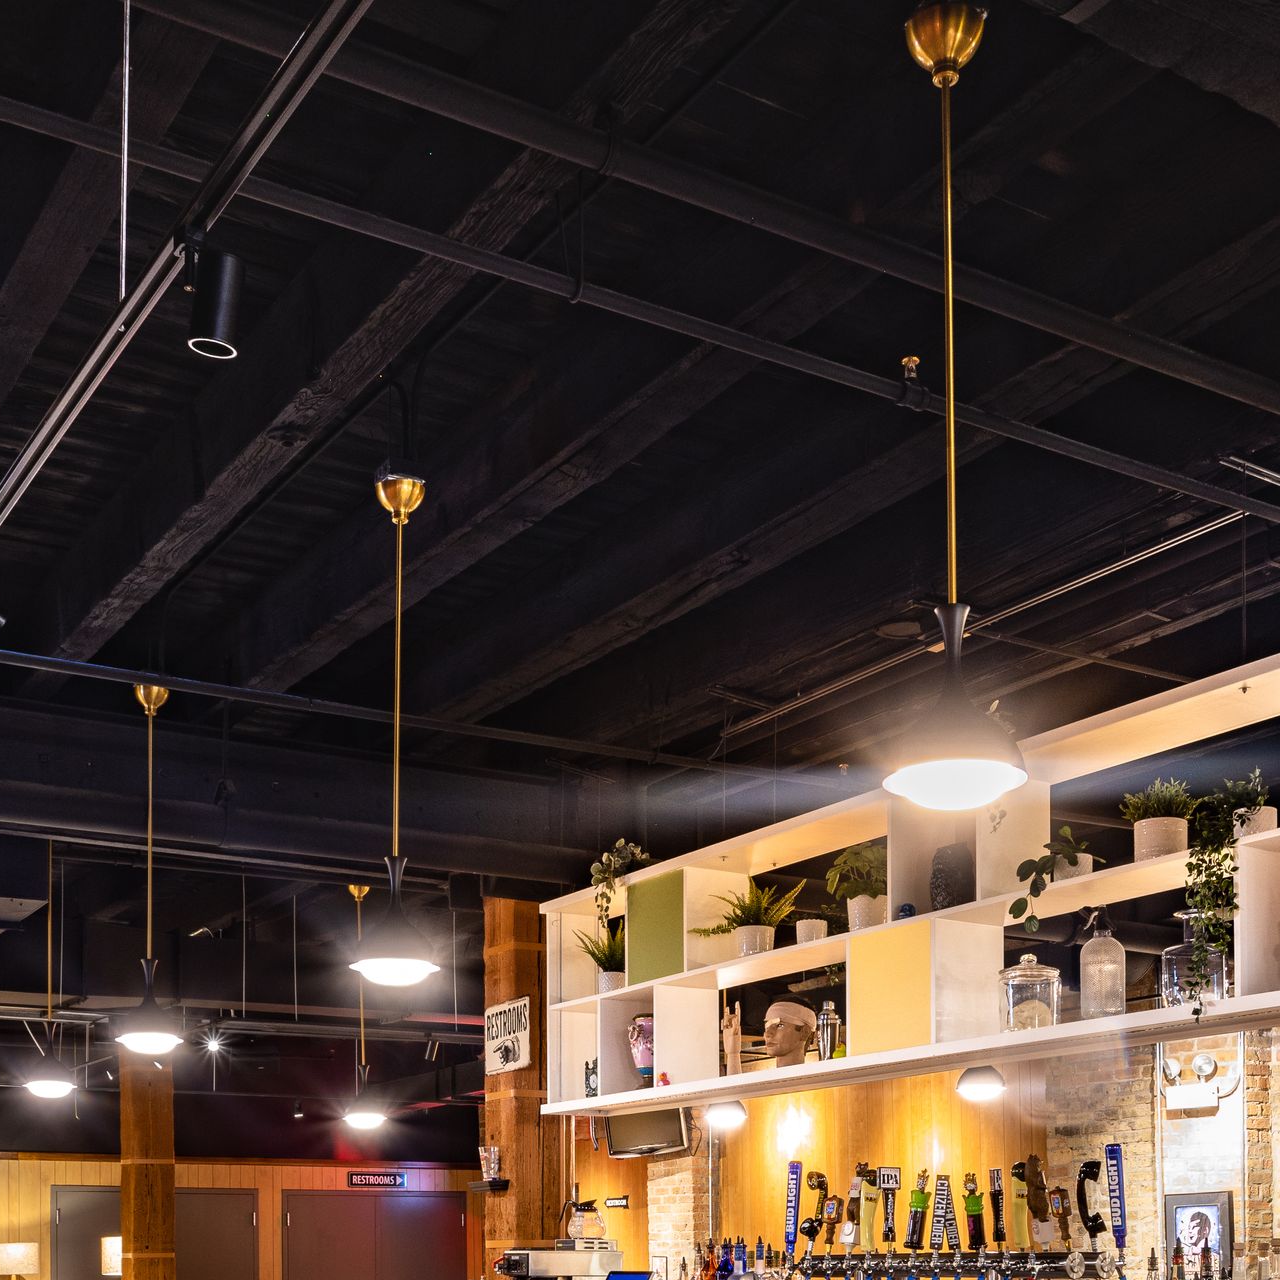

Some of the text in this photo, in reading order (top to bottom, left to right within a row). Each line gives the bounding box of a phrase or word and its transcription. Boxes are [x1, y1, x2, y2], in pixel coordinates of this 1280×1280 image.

[486, 1003, 528, 1042] RESTROOMS
[352, 1175, 395, 1185] RESTROOMS
[881, 1173, 899, 1185] IPA
[1107, 1158, 1122, 1226] BUD LIGHT
[785, 1172, 797, 1233] BUD LIGHT
[931, 1180, 948, 1244] CITIZEN CIDER
[945, 1220, 959, 1245] CIDER
